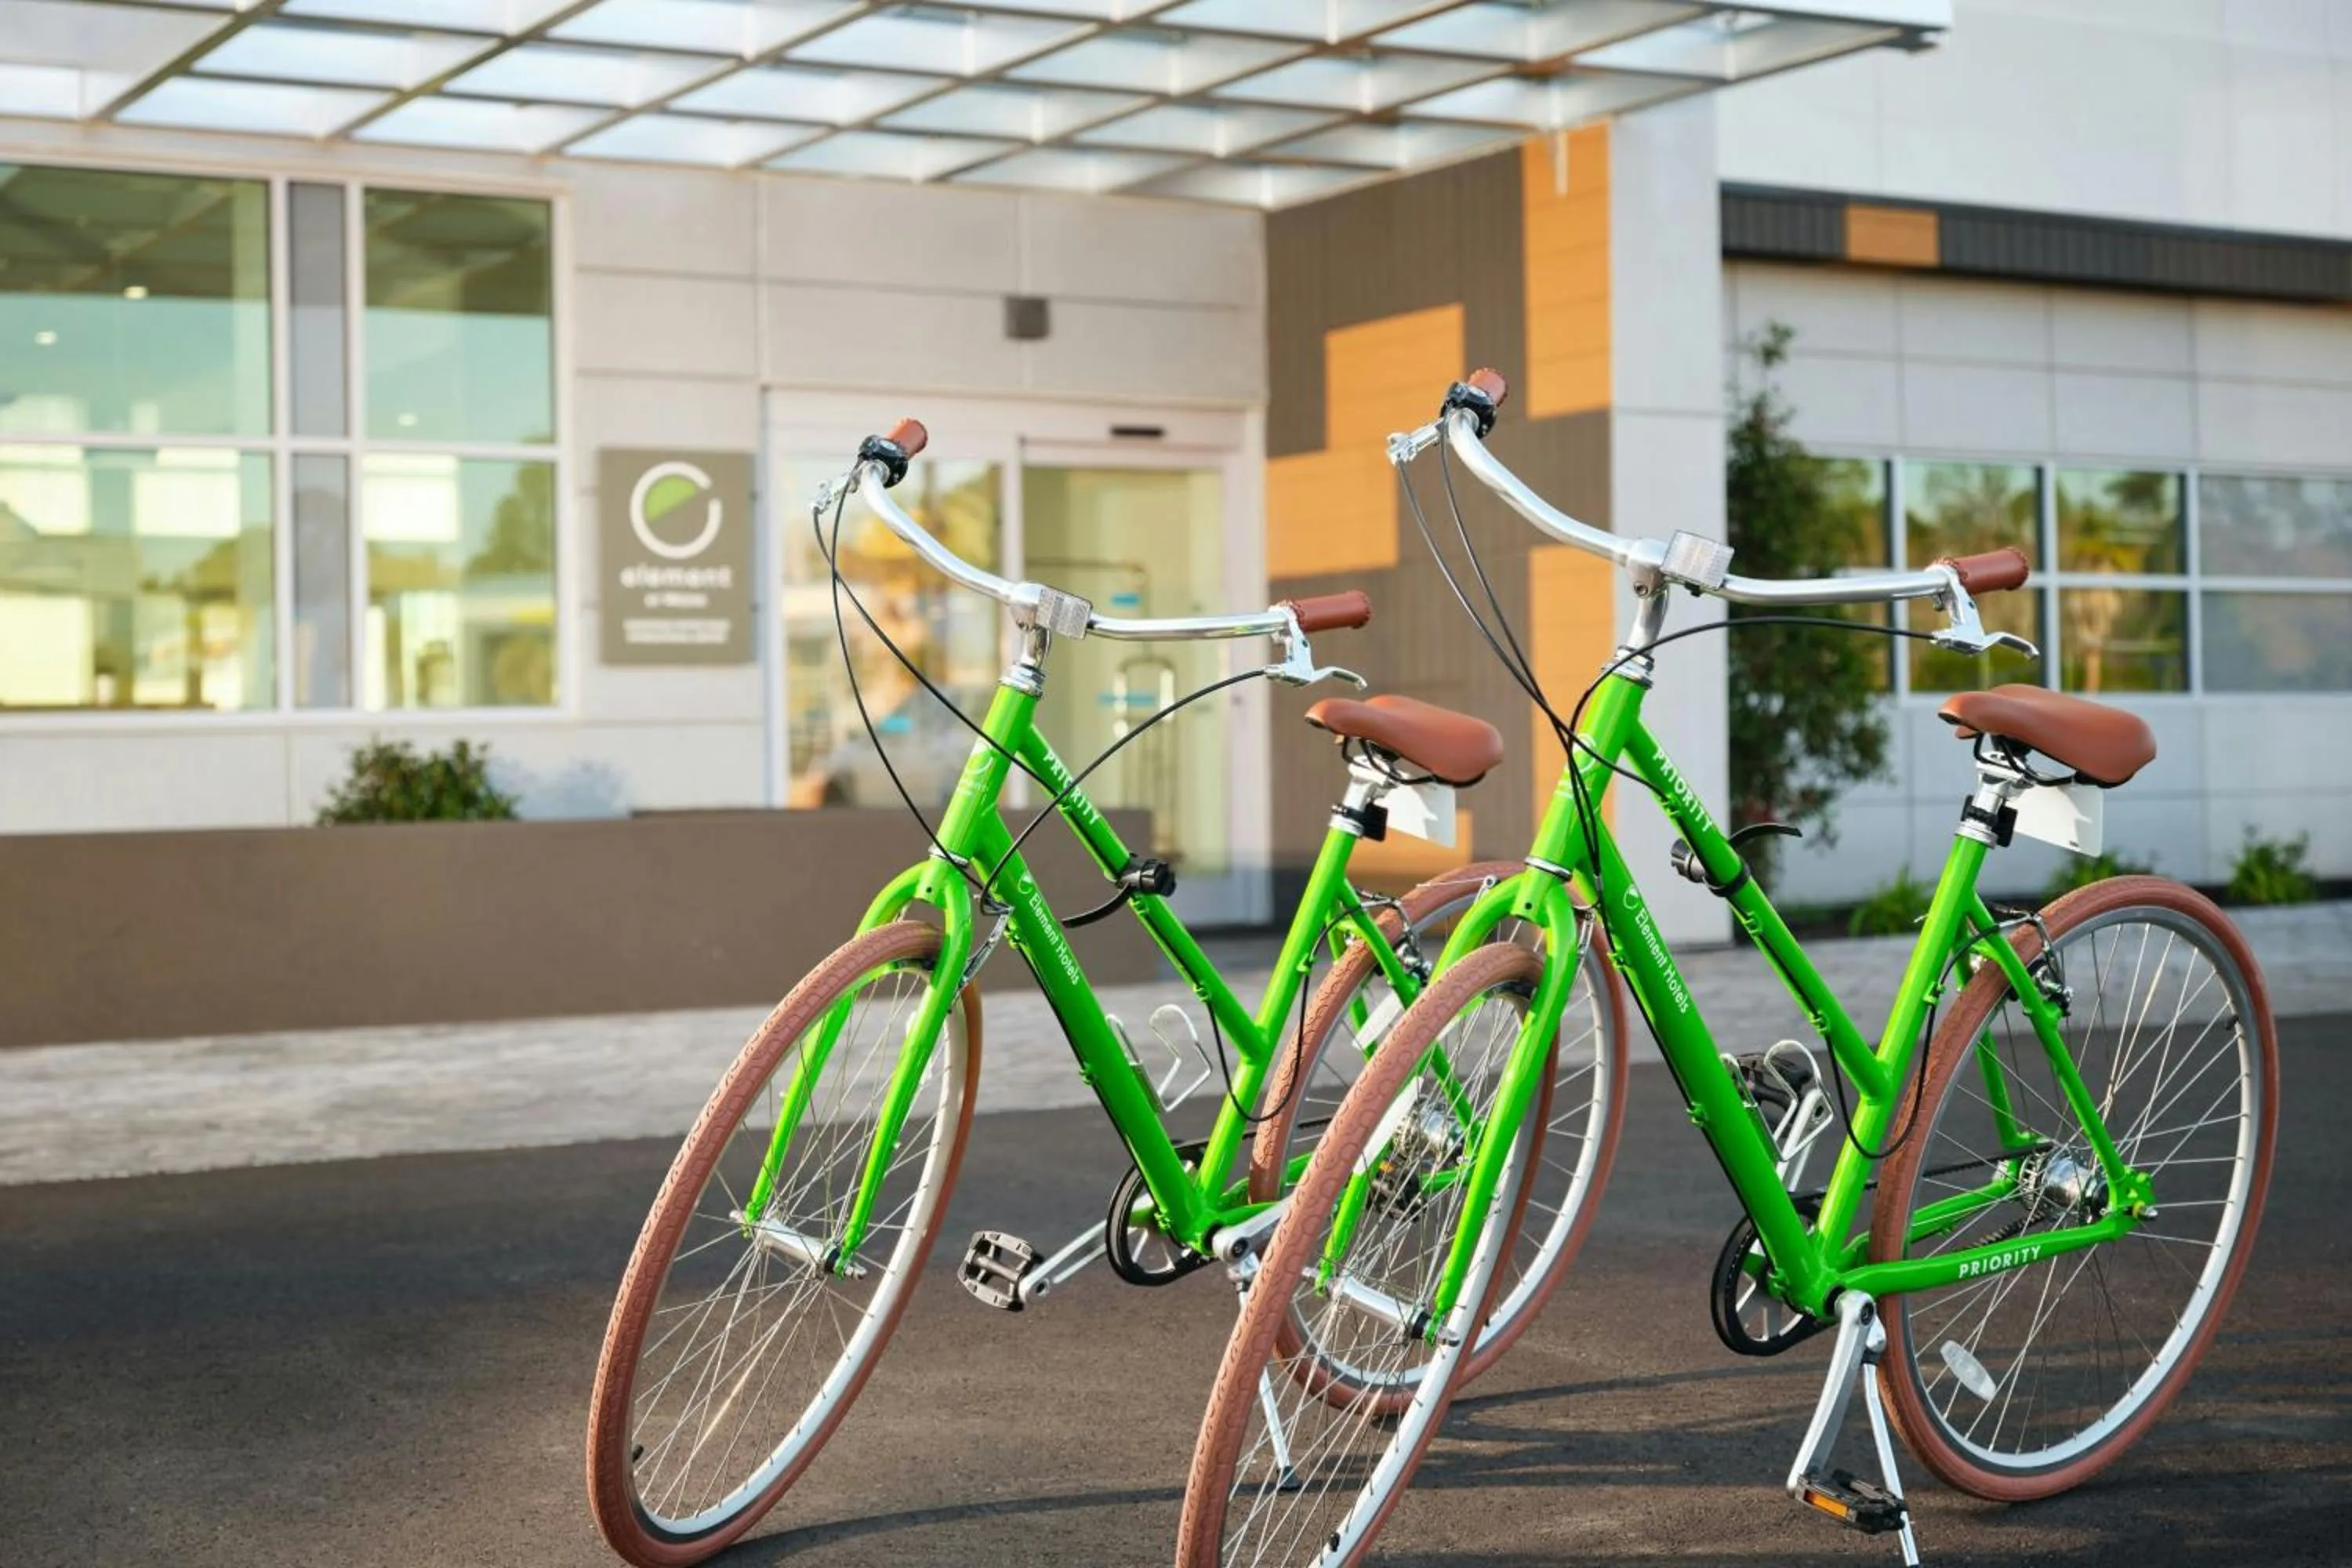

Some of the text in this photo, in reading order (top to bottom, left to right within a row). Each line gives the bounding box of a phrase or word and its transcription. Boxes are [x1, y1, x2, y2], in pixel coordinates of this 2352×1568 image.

[1653, 745, 1712, 832] PRIORITY
[1029, 893, 1080, 985] Element Hotels
[1635, 908, 1688, 1014] Element Hotels
[1958, 1245, 2042, 1279] PRIORITY
